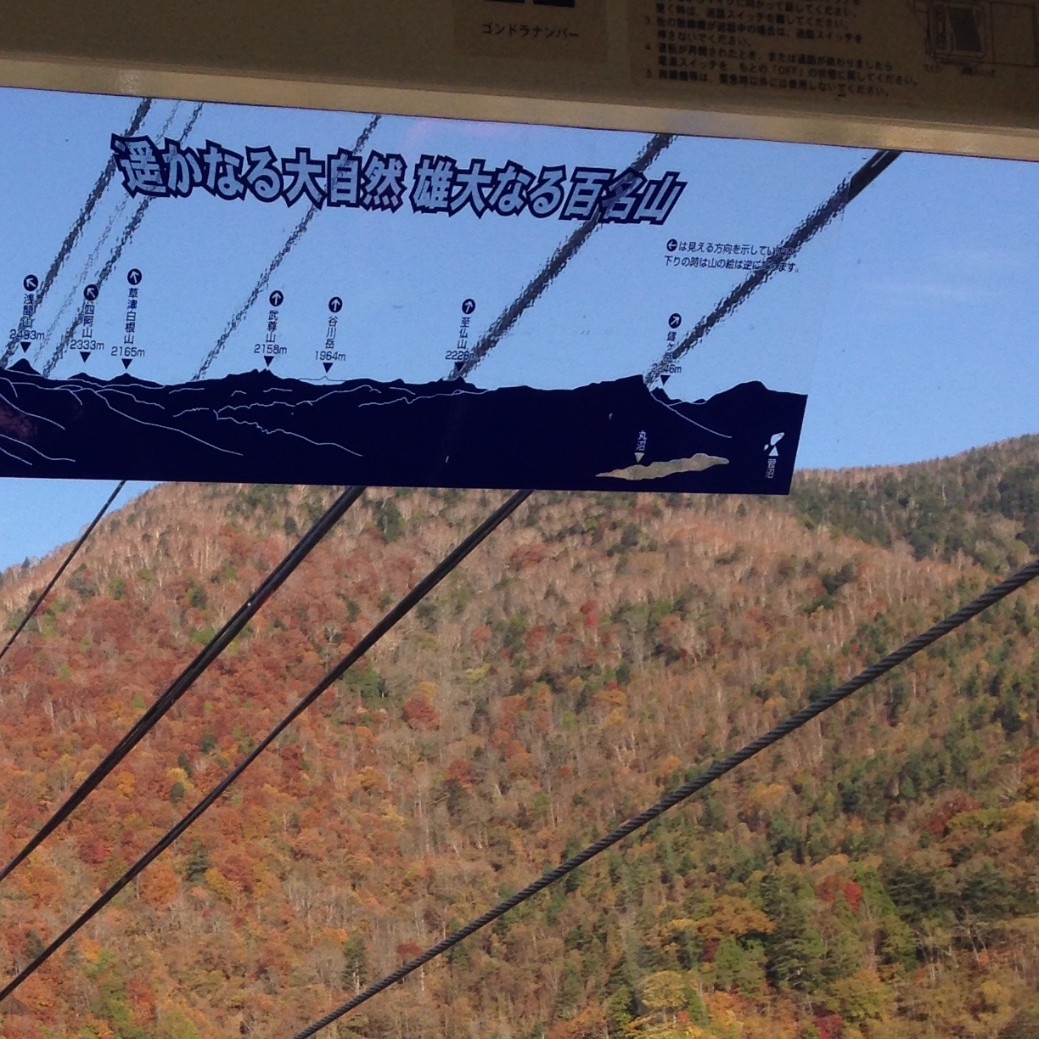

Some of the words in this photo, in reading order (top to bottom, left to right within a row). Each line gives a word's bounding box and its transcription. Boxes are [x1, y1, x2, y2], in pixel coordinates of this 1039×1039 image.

[481, 23, 580, 38] ゴンドラナンバー
[111, 133, 408, 213] 遥かなる大自然
[408, 154, 688, 225] 雄大なる百名山
[22, 293, 35, 328] 浅間山
[124, 287, 139, 345] 草津白根山
[9, 328, 45, 340] 2493m
[265, 309, 279, 344] 武尊山
[325, 315, 339, 350] 谷川岳
[457, 316, 471, 350] 至仏山
[70, 339, 105, 350] 2333m
[111, 345, 146, 357] 2165m
[253, 343, 288, 355] 2158m
[315, 350, 347, 362] 1964m
